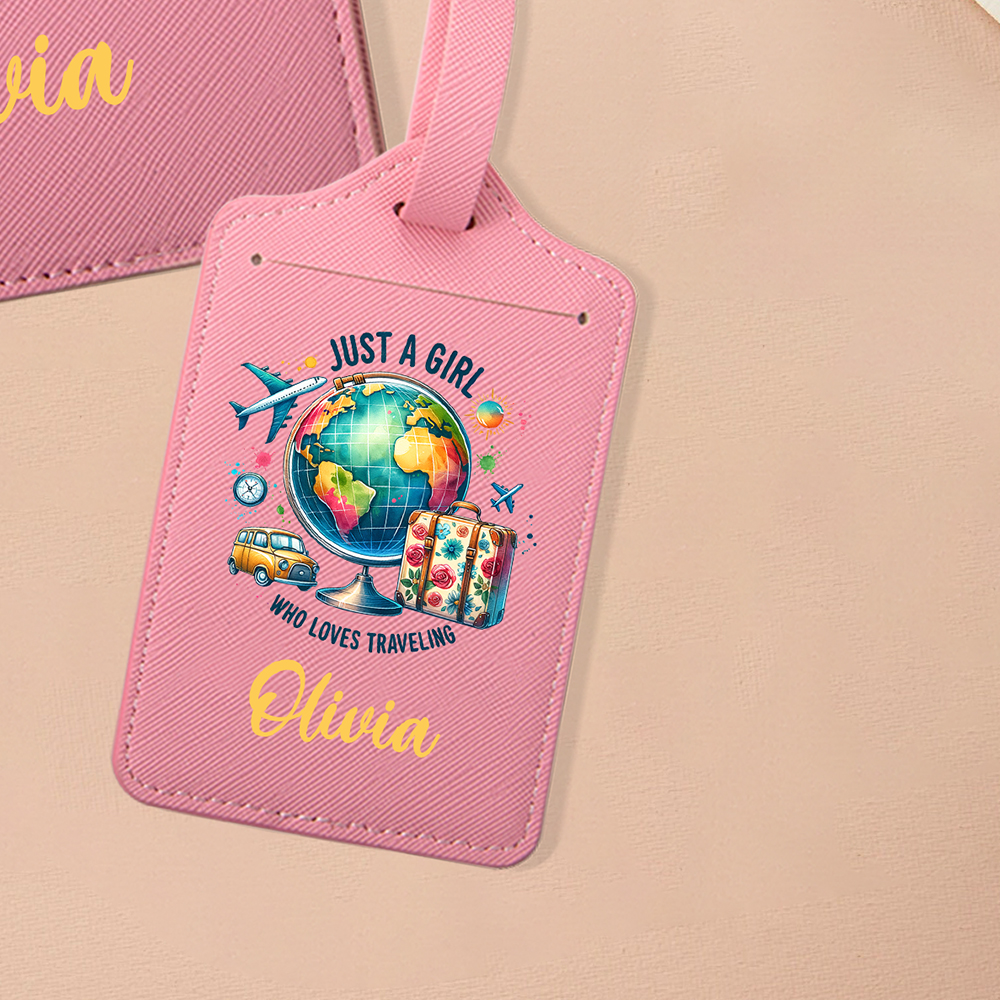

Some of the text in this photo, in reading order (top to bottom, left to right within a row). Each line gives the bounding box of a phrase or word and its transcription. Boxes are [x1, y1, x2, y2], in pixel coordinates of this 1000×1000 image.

[331, 332, 485, 399] JUST A GIRL
[270, 595, 455, 653] WHO LOVES TRAVELING
[249, 659, 441, 758] Olivia
